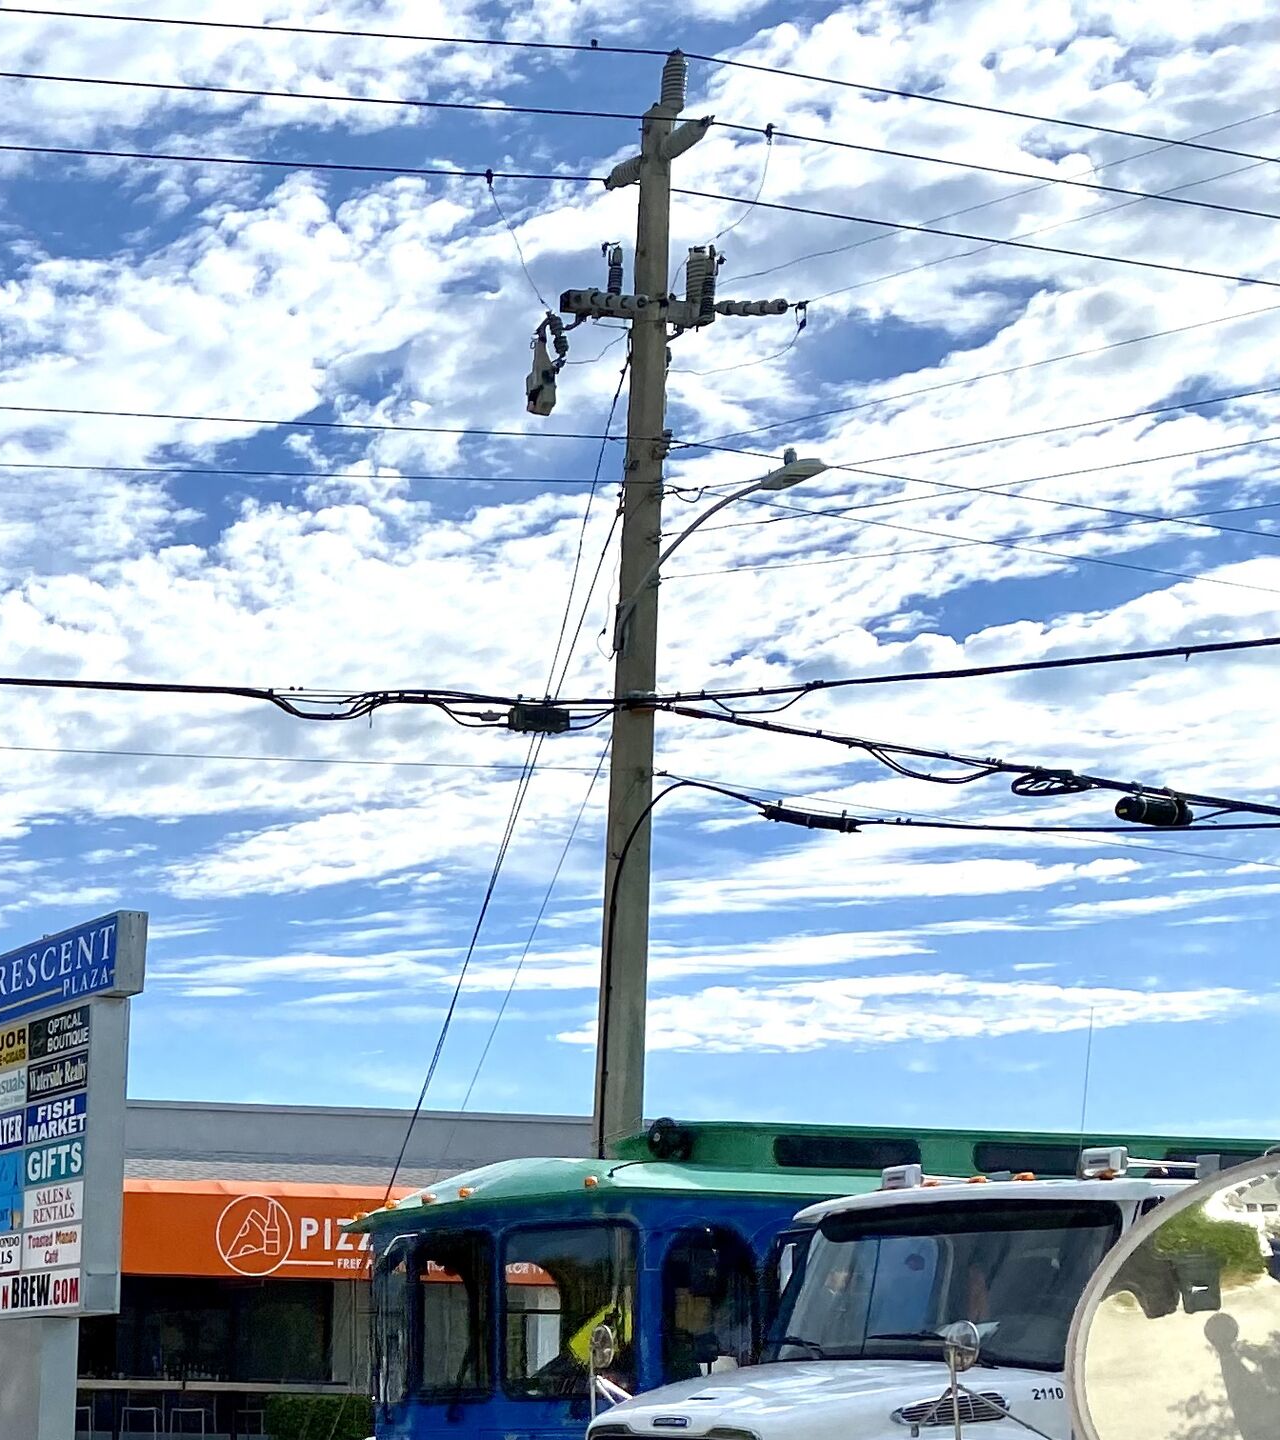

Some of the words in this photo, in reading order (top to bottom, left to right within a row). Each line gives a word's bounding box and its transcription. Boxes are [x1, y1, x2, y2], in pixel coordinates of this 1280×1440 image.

[62, 964, 110, 997] PLAZA
[47, 1011, 83, 1035] OPTICAL
[46, 1026, 89, 1053] BOUTIQUE
[29, 1062, 64, 1092] Waterside
[64, 1057, 87, 1084] Realty
[37, 1098, 75, 1123] FISH
[27, 1112, 87, 1144] MARKET
[27, 1141, 82, 1182] GIFTS
[36, 1187, 64, 1207] SALES
[65, 1187, 72, 1201] &
[32, 1202, 76, 1225] RENTALS
[28, 1232, 53, 1250] Toasted
[1031, 1387, 1064, 1401] 2110
